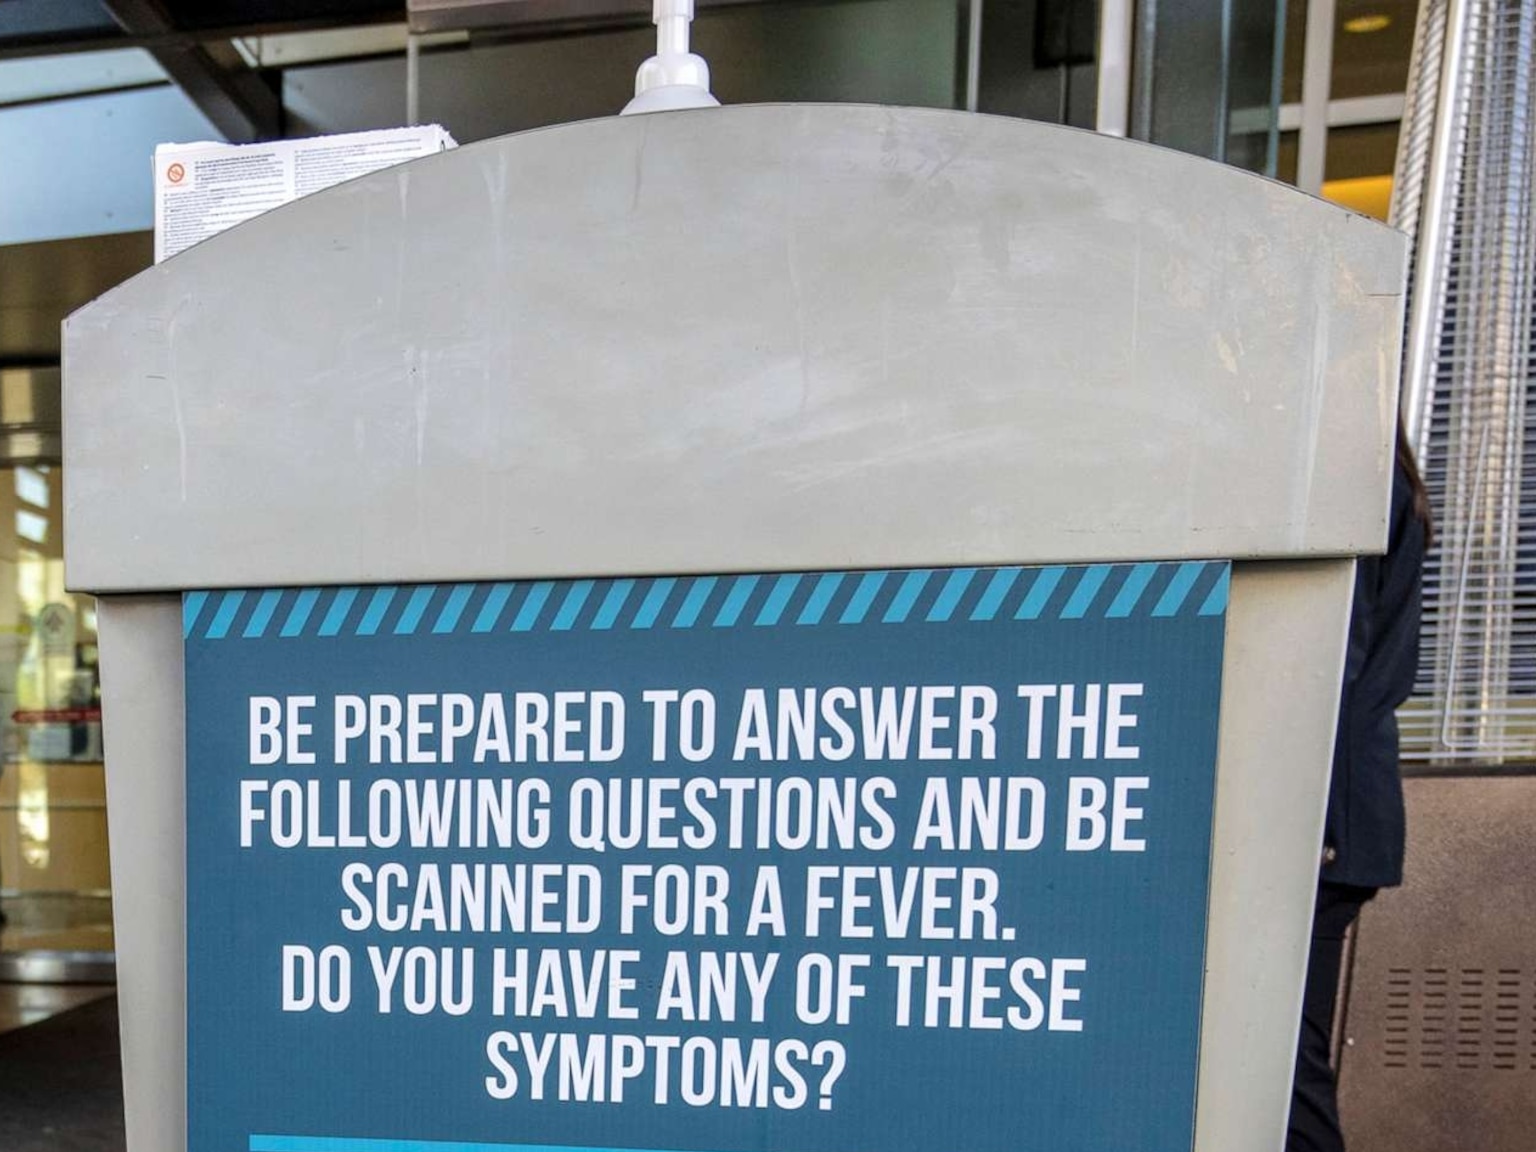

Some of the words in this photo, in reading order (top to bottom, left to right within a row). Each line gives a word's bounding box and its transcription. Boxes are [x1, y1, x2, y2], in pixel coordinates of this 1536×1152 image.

[250, 696, 316, 764] BE
[335, 691, 625, 763] PREPARED
[643, 689, 715, 761] TO
[733, 686, 997, 760] ANSWER
[1018, 683, 1143, 759] THE
[241, 778, 550, 848] FOLLOWING
[569, 777, 897, 852] QUESTIONS
[913, 777, 1046, 850] AND
[1066, 777, 1149, 851] BE
[341, 863, 601, 933] SCANNED
[621, 864, 729, 935] FOR
[746, 866, 786, 936] A
[806, 866, 1015, 940] FEVER.
[283, 945, 351, 1012] DO
[367, 946, 474, 1015] YOU
[493, 948, 640, 1019] HAVE
[656, 951, 780, 1022] ANY
[796, 953, 870, 1024] OF
[887, 955, 1086, 1031] THESE
[486, 1031, 846, 1110] SYMPTOMS?
